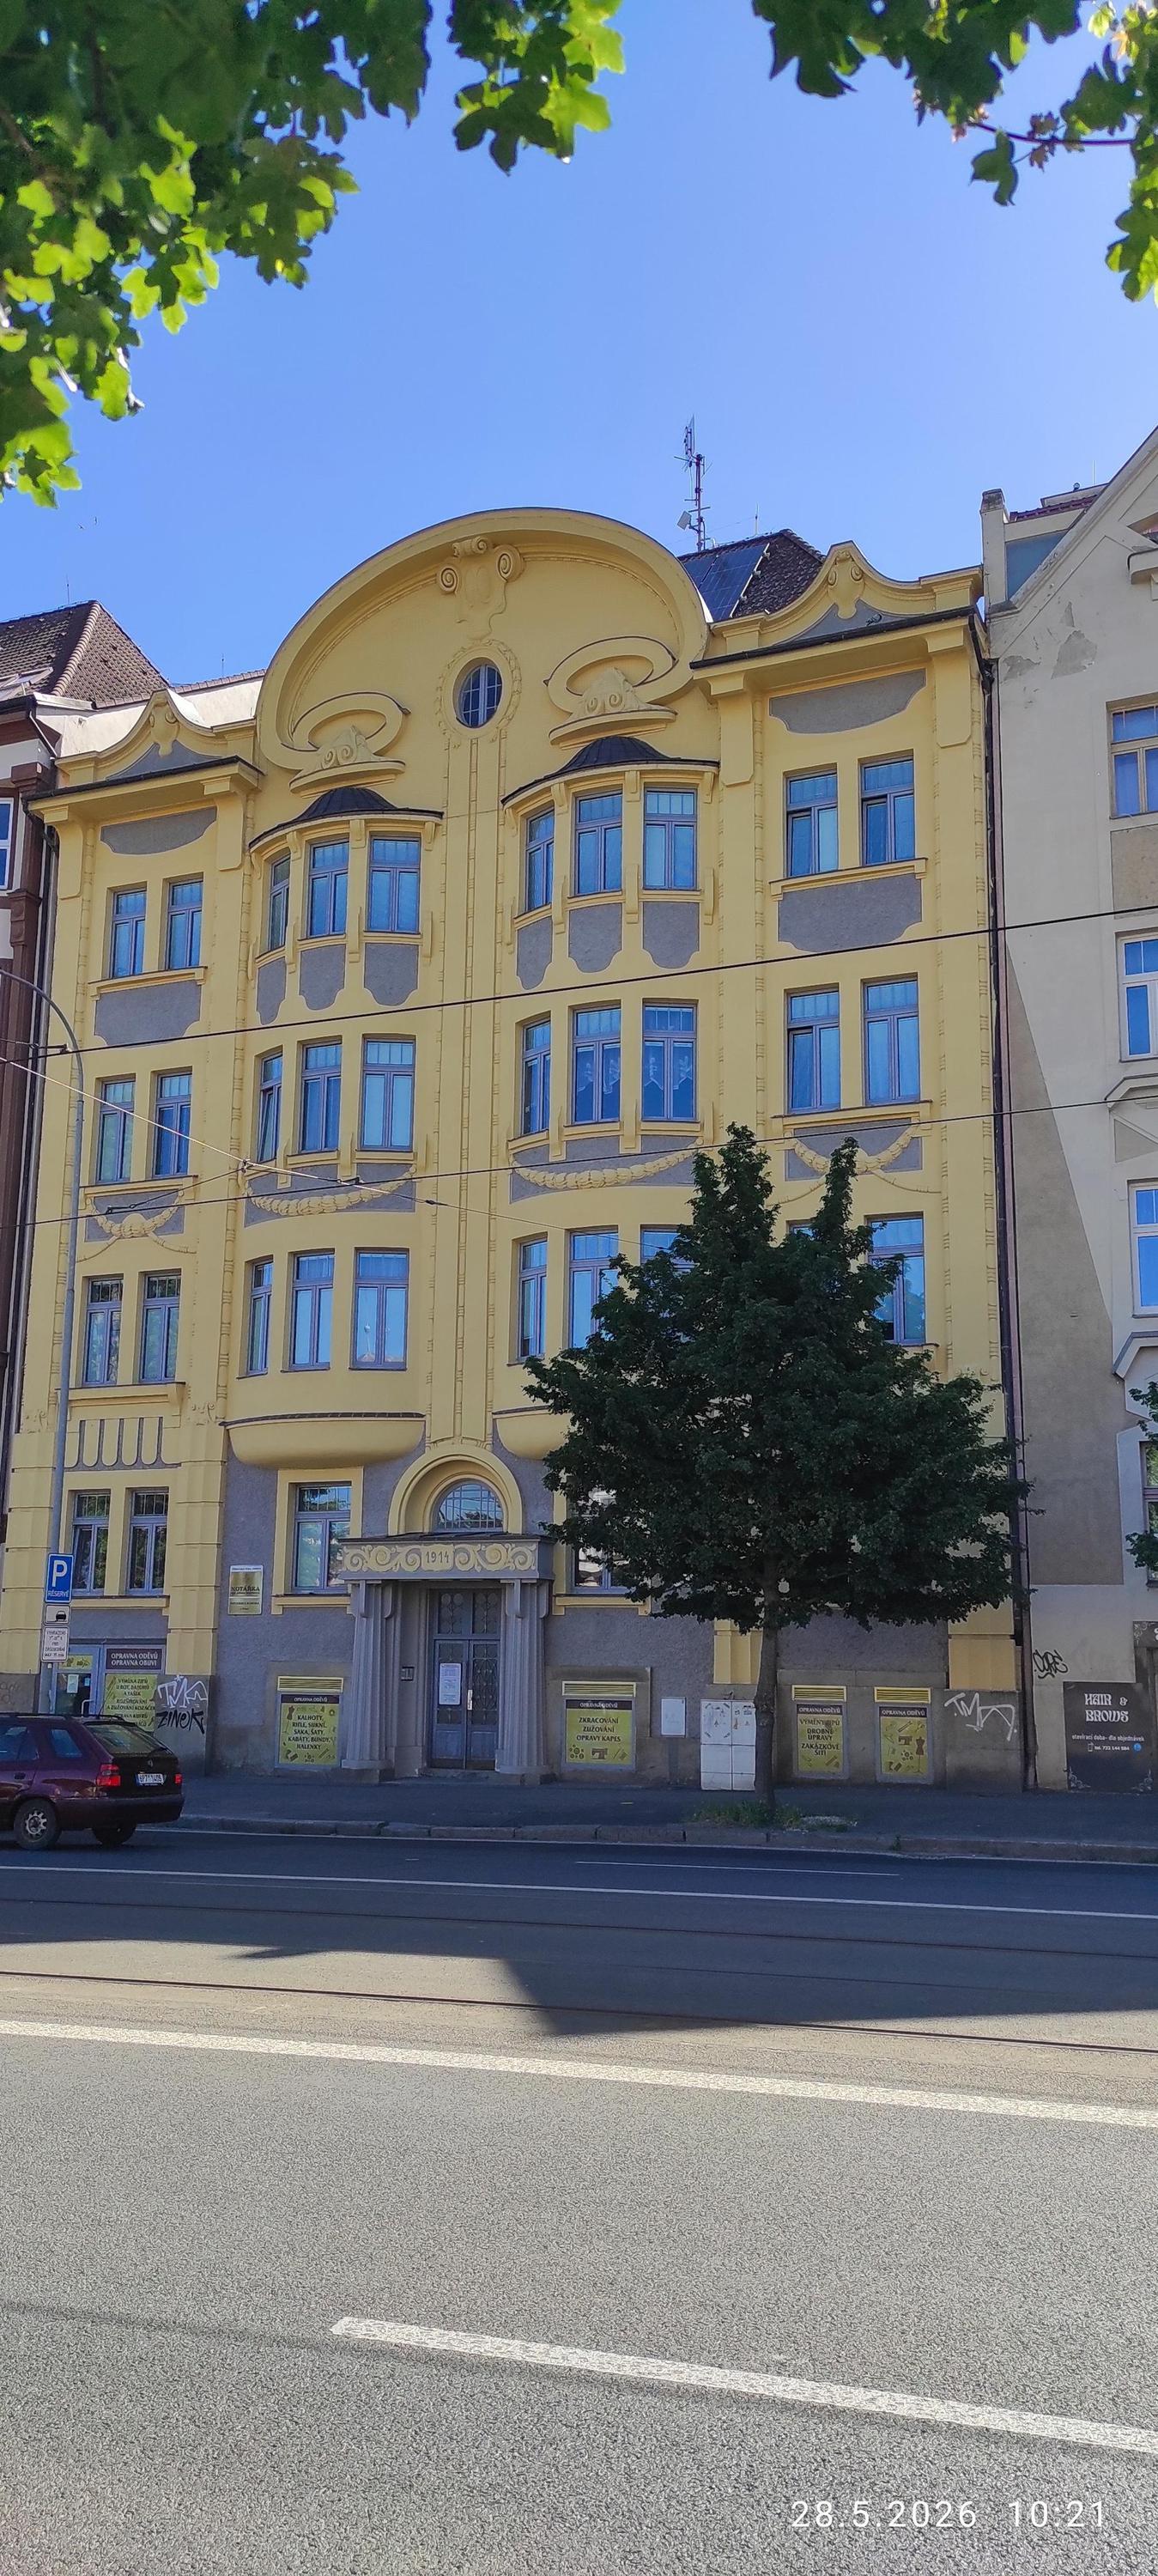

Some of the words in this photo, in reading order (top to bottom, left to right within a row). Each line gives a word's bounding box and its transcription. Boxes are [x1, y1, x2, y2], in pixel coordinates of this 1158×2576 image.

[426, 1551, 449, 1564] 1914
[52, 1559, 68, 1588] P
[138, 1651, 159, 1660] ODĚVŮ
[1084, 1692, 1113, 1706] HAIR
[1119, 1696, 1128, 1706] &
[1084, 1710, 1130, 1723] BROWS
[310, 1728, 325, 1736] ŠATY,
[801, 1742, 840, 1751] ZAKÁZKOVÉ
